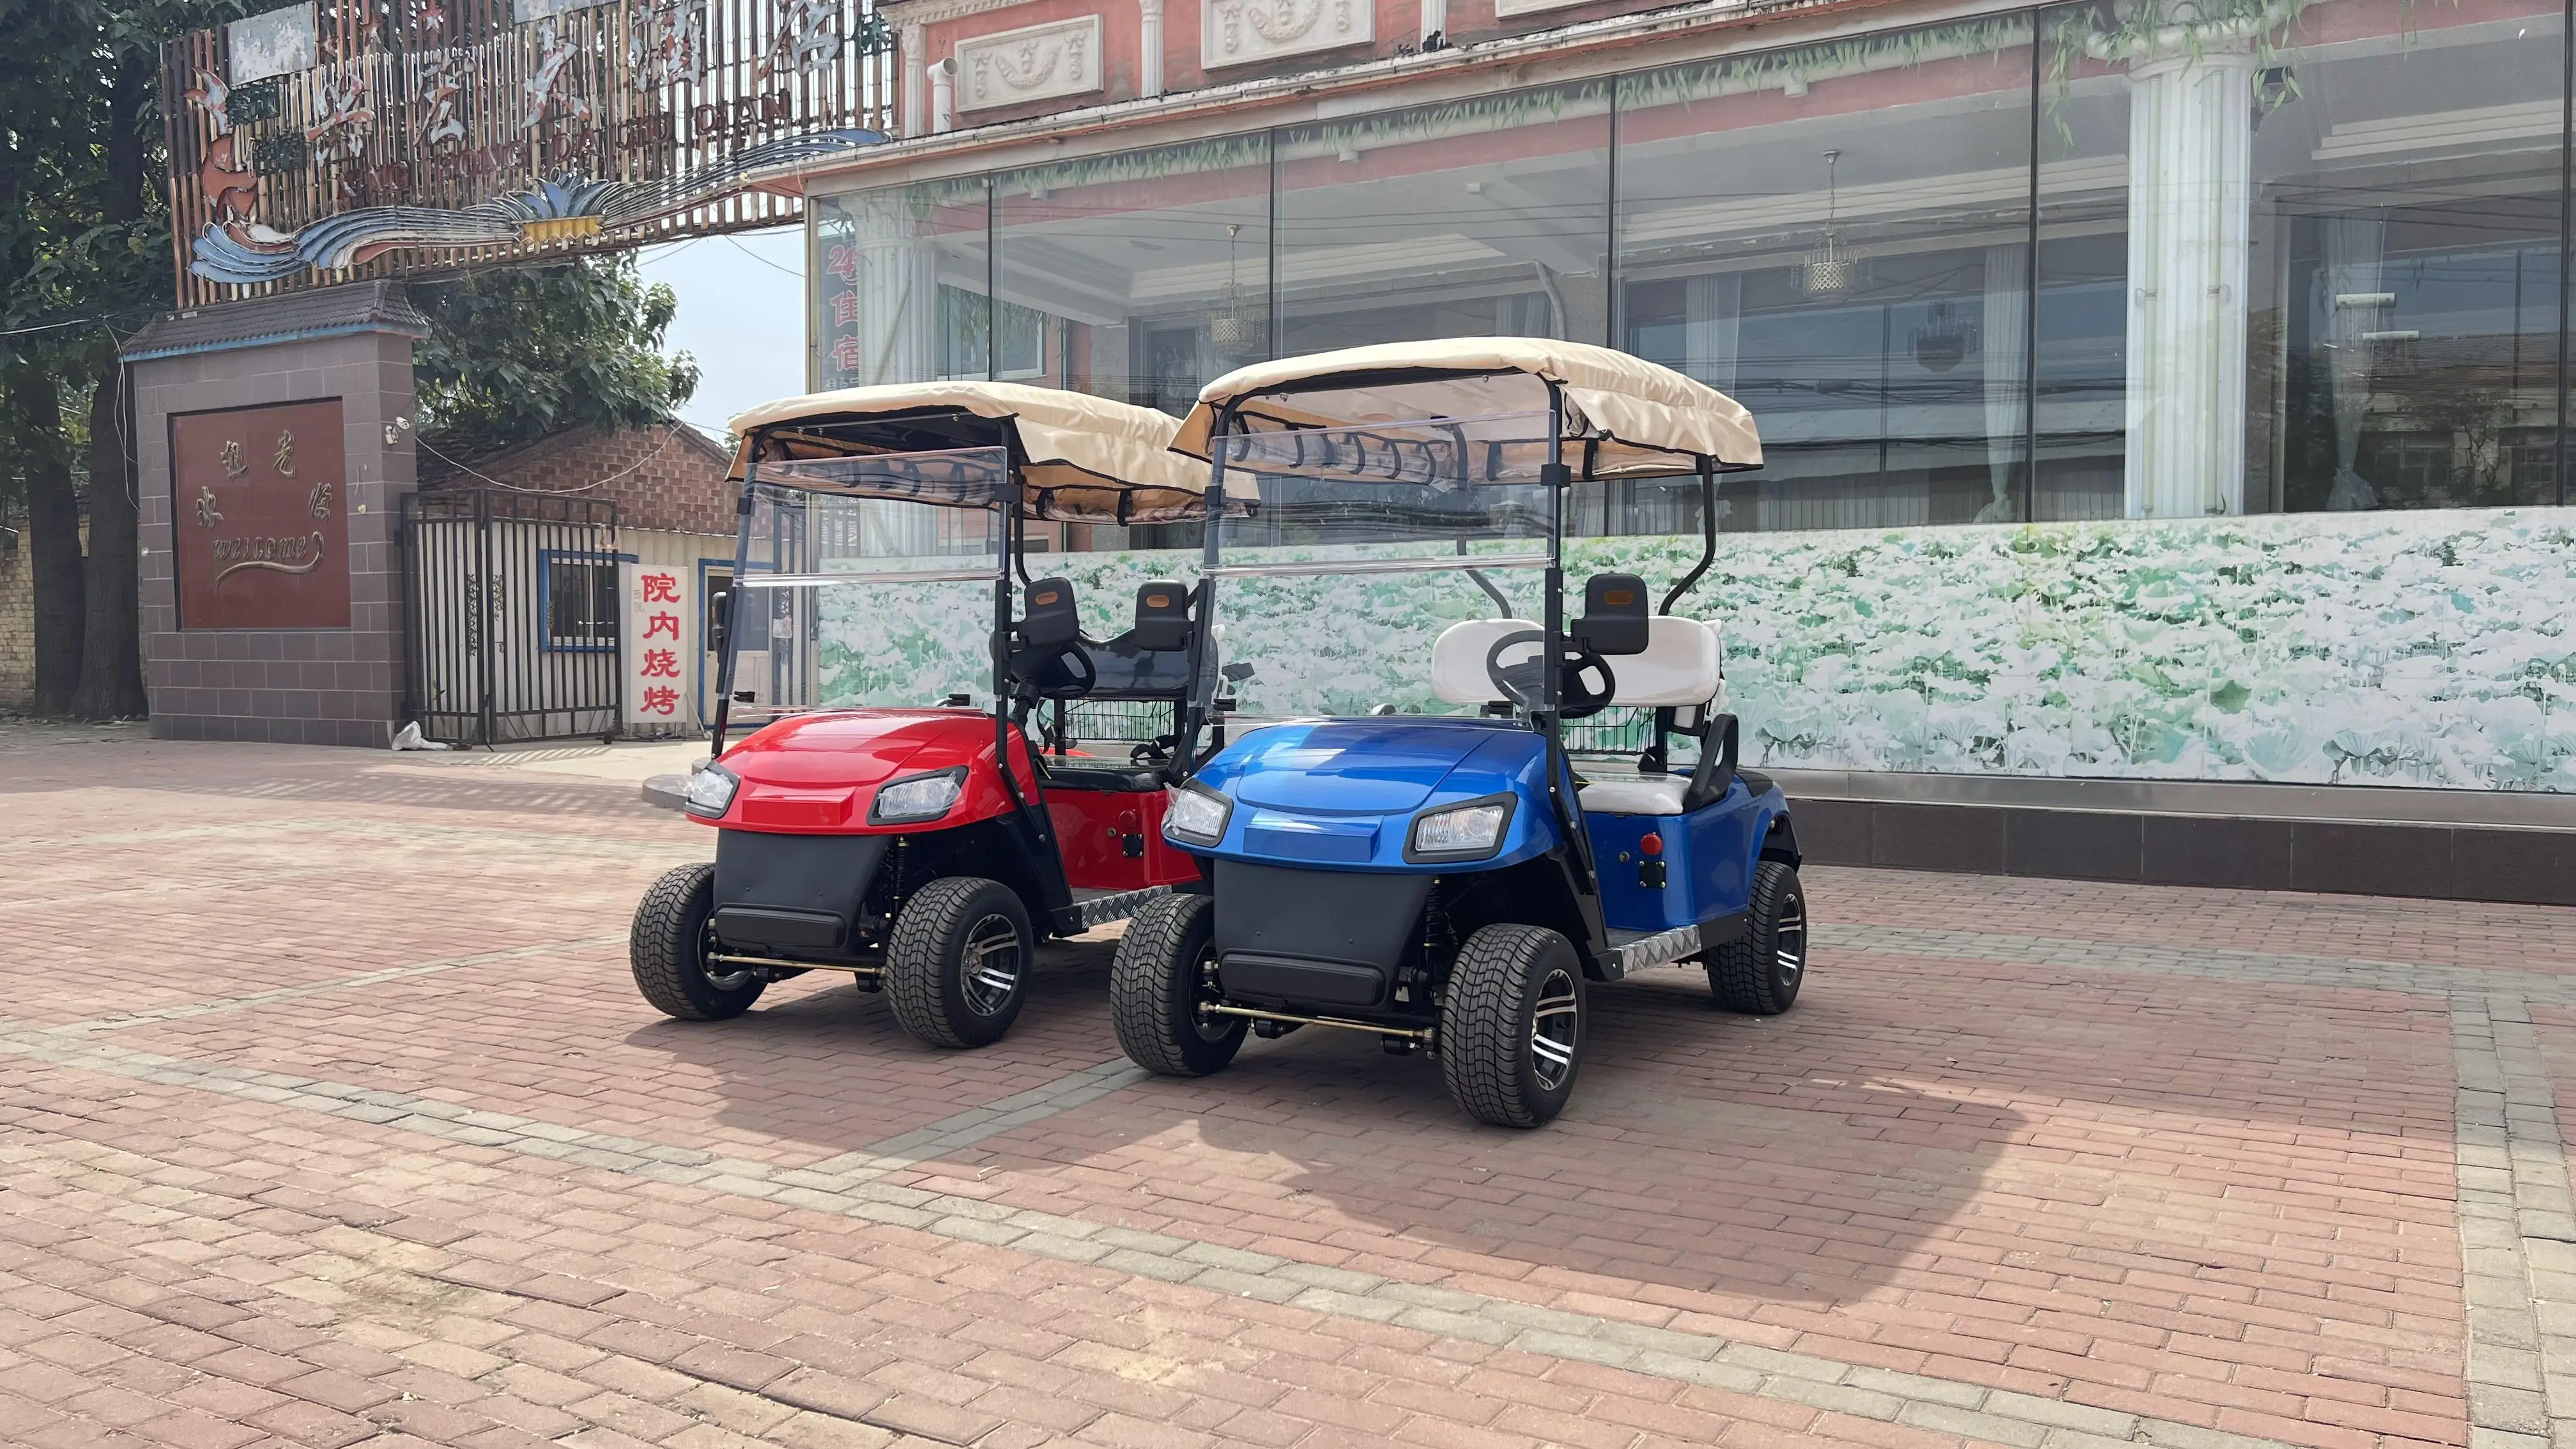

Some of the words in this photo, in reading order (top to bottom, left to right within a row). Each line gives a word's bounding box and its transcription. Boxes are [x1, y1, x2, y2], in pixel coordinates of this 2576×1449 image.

[695, 88, 792, 135] DIAN
[640, 572, 681, 716] 院内烧烤
